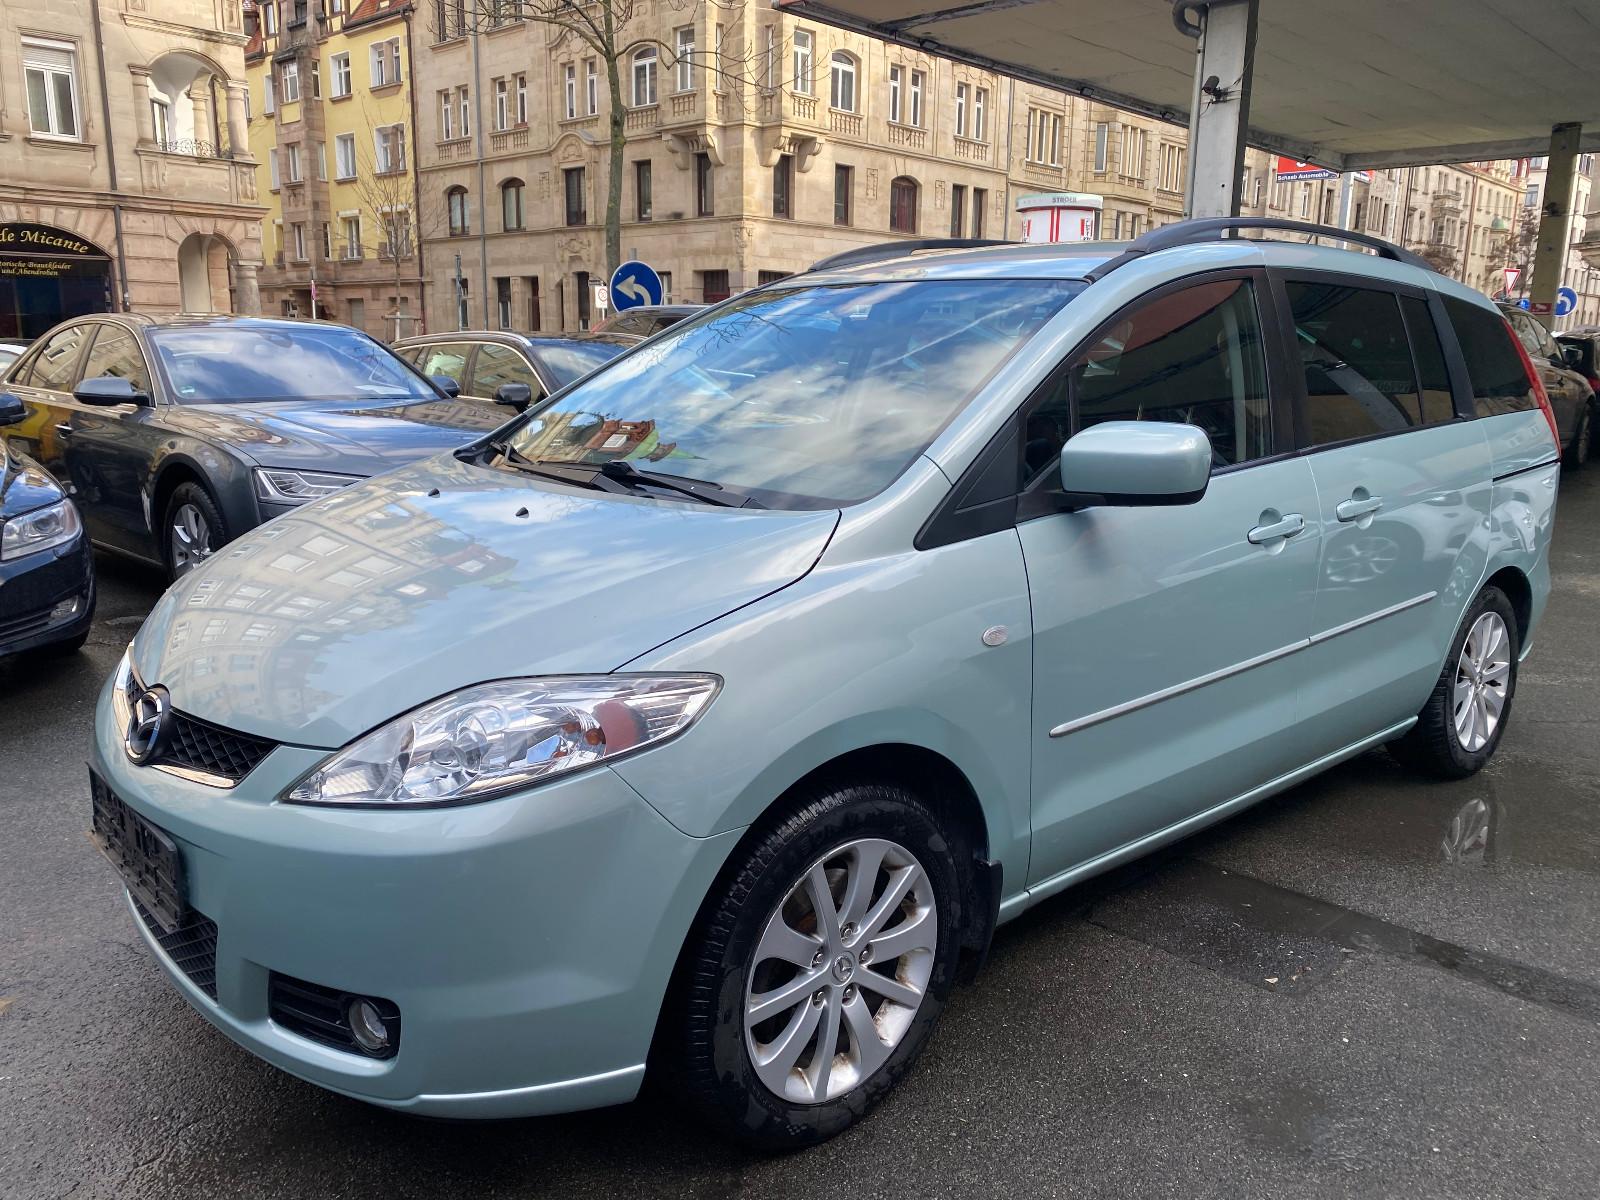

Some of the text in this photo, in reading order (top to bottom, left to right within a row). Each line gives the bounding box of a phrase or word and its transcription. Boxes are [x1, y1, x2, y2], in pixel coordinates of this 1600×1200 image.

[1298, 172, 1329, 180] Automobile
[20, 230, 89, 253] Micante
[28, 261, 72, 270] Brautkleider
[16, 268, 58, 276] Abendroben
